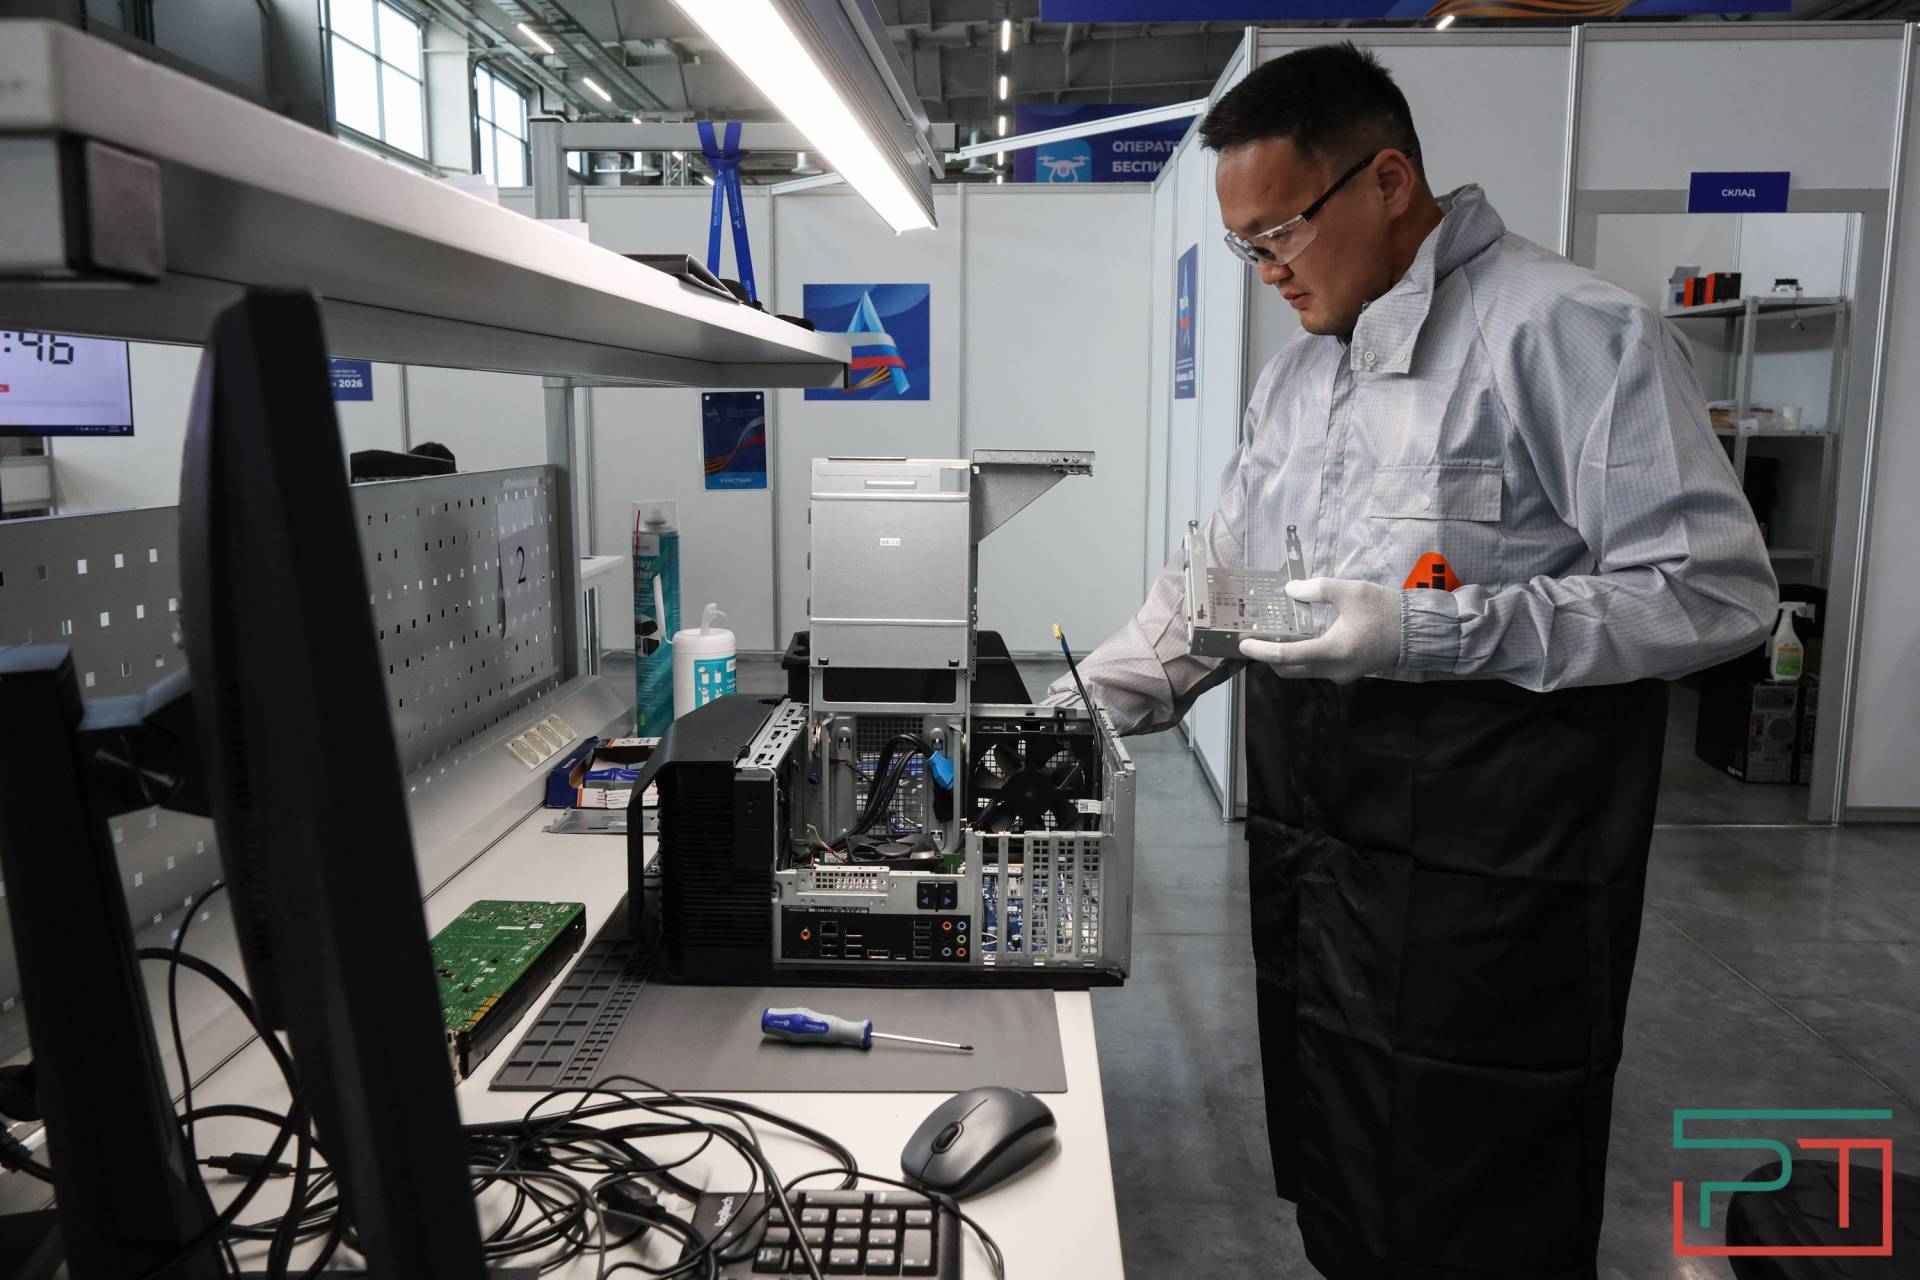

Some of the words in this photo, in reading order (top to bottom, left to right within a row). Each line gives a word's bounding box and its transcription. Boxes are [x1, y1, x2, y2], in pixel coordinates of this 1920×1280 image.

[1721, 188, 1756, 198] СКЛАД
[338, 379, 364, 388] 2026
[516, 546, 527, 584] 2
